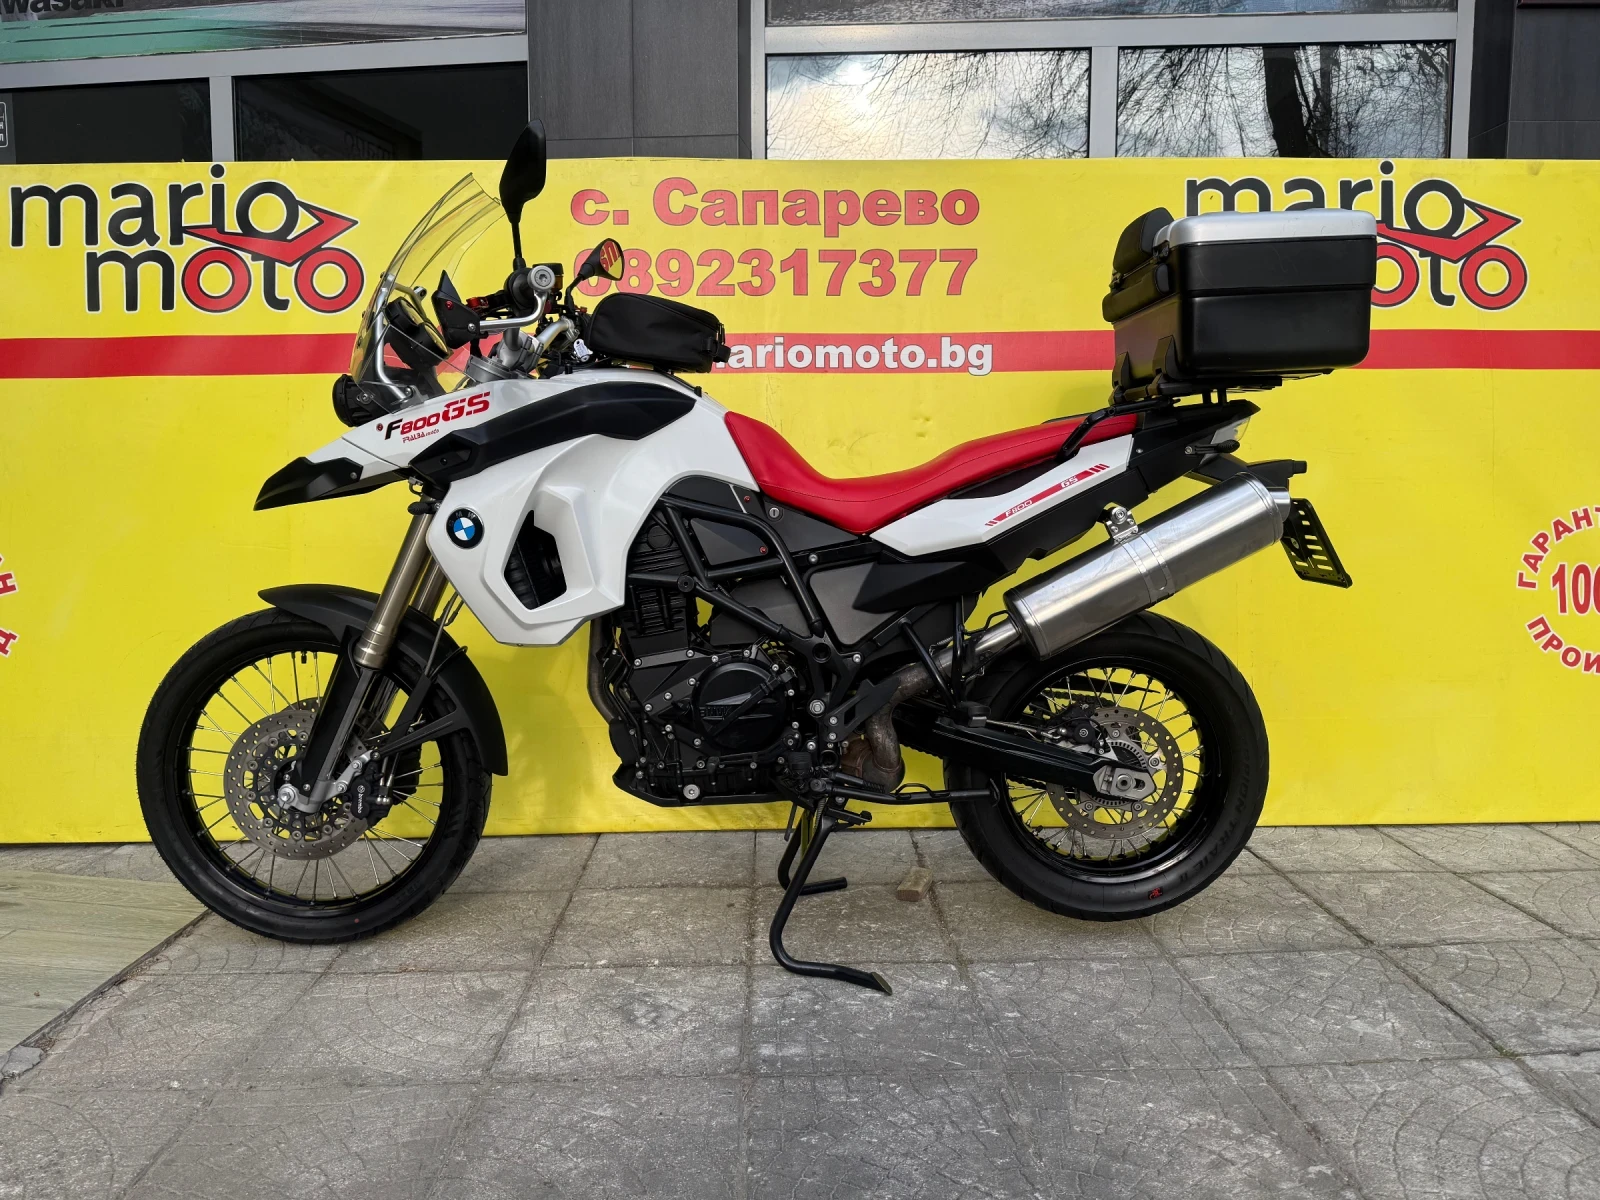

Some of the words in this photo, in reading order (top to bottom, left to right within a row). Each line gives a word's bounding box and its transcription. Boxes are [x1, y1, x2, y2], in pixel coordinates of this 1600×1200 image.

[10, 163, 299, 247] mario
[570, 188, 629, 226] с.
[653, 176, 980, 238] Сапарево
[86, 246, 365, 313] moto
[573, 248, 978, 297] 0892317377
[1371, 241, 1527, 311] oto
[715, 336, 993, 376] ariomoto.bg
[1060, 475, 1079, 489] GS
